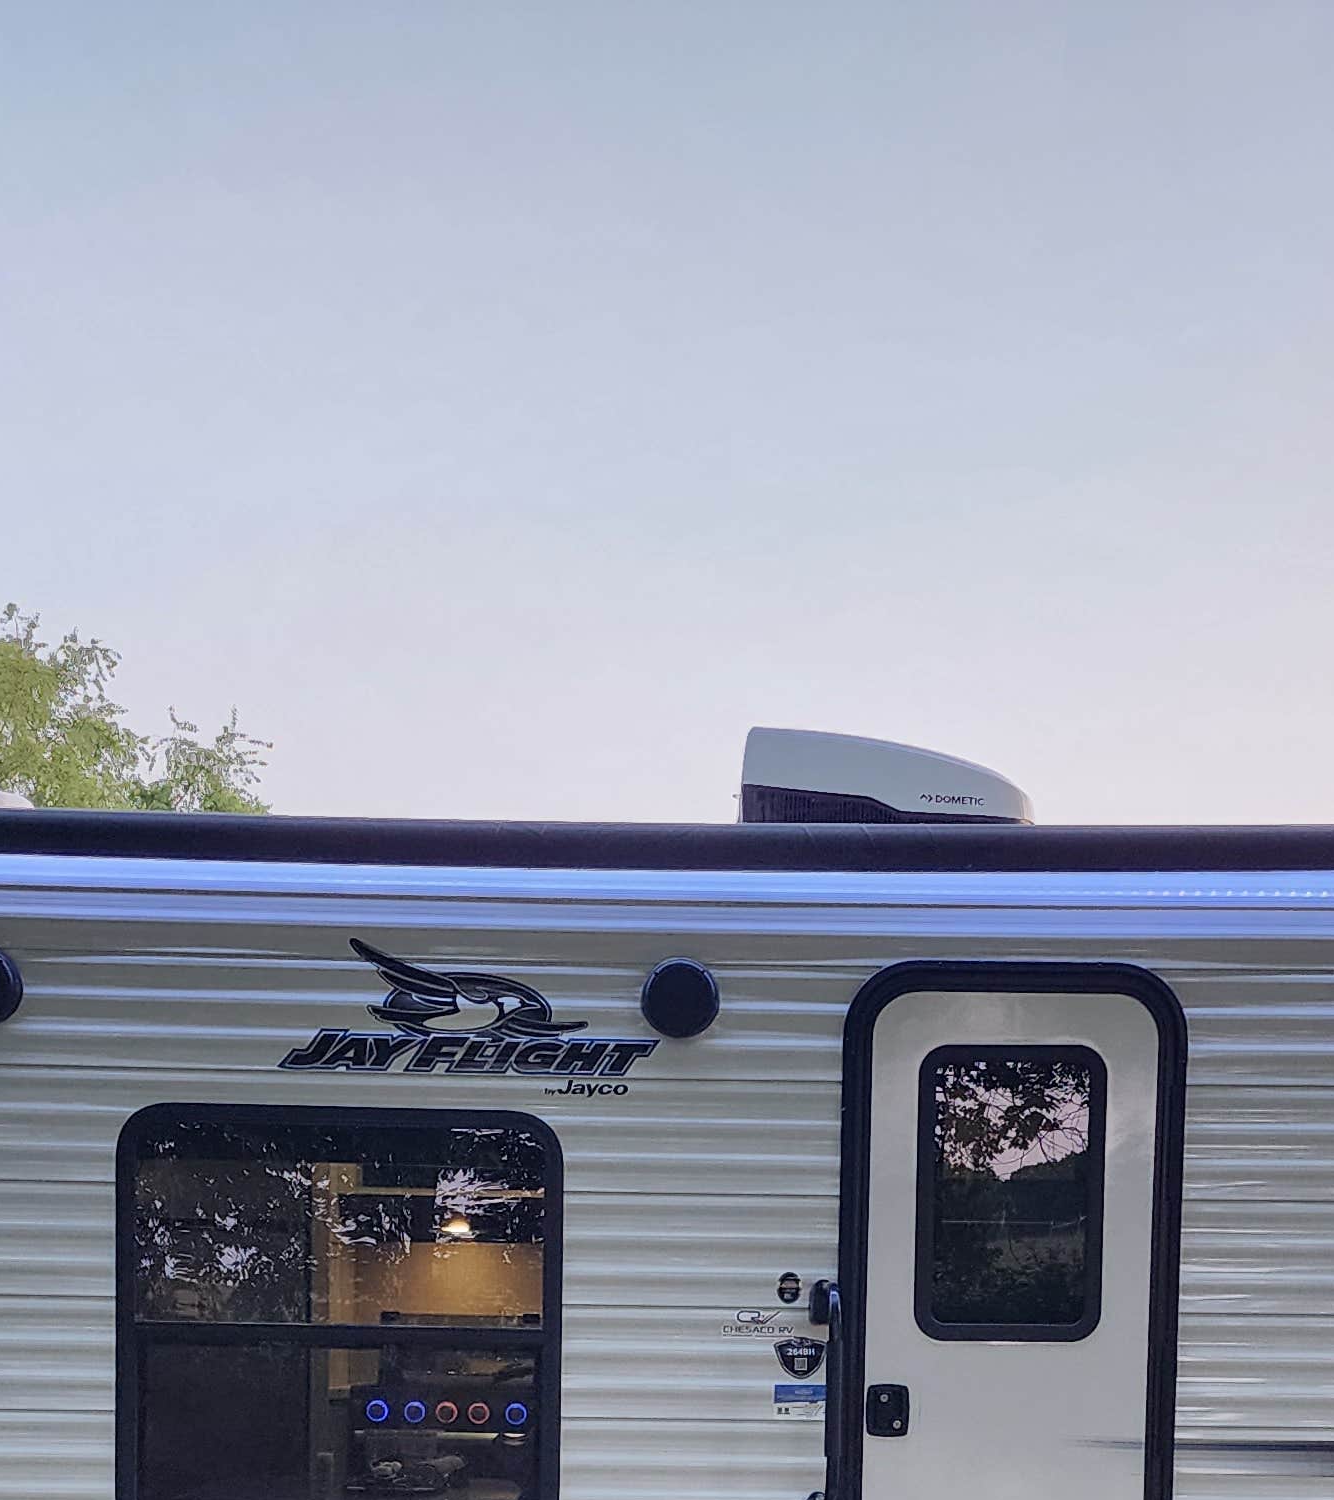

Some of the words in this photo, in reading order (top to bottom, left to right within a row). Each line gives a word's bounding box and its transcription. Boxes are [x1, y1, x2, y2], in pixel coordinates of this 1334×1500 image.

[935, 794, 986, 806] DOMETIC
[278, 1028, 421, 1071] JAY
[404, 1033, 660, 1077] FLIGHT
[558, 1080, 629, 1098] Jayco
[778, 1326, 794, 1334] RV
